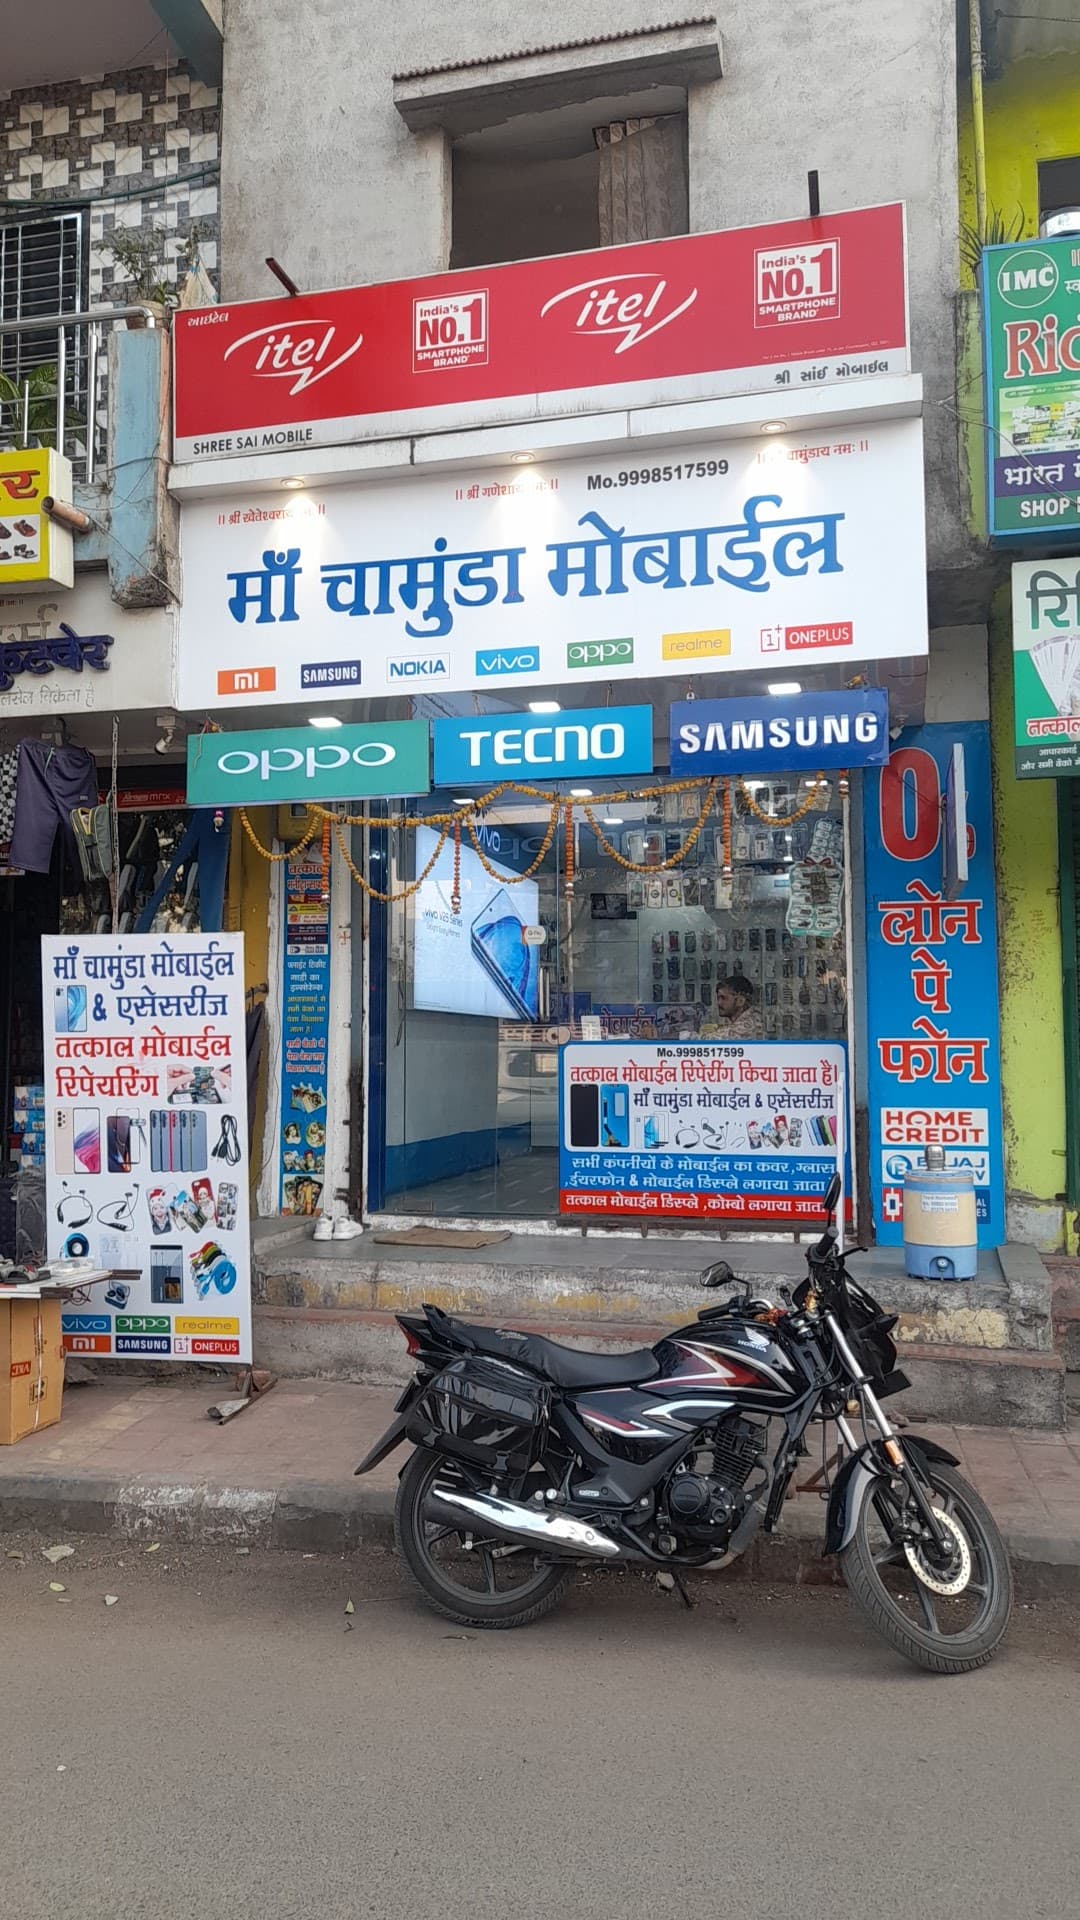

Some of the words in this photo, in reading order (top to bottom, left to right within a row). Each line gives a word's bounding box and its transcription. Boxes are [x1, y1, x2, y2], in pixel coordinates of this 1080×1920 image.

[761, 254, 806, 269] India's
[1002, 266, 1055, 292] IMC
[420, 304, 459, 318] India's
[576, 281, 667, 327] itel
[759, 297, 837, 315] SMARTPHONE
[777, 309, 816, 321] BRAND
[255, 326, 336, 370] itel
[416, 345, 485, 361] SMARTPHONE
[433, 356, 468, 367] BRAND
[193, 440, 233, 455] SHREE
[236, 436, 259, 450] SAI
[262, 428, 313, 446] MOBILE
[587, 459, 729, 490] Mo.9998517599
[1003, 463, 1066, 486] भारत
[1020, 498, 1071, 518] SHOP
[226, 547, 303, 625] माँ
[320, 537, 527, 638] चामुंडा
[546, 494, 845, 597] मोबाईल
[303, 666, 358, 684] SAMSUNG
[389, 659, 447, 677] NOKIA
[480, 653, 536, 672] vivo
[568, 640, 632, 663] oppo
[669, 636, 723, 653] realme
[788, 627, 850, 645] ONEPLUS
[459, 722, 625, 768] TECNO
[680, 711, 879, 755] SAMSUNG
[878, 878, 983, 945] लोन
[53, 945, 79, 980] माँ
[83, 944, 146, 990] चामुंडा
[151, 941, 234, 981] मोबाईल
[911, 947, 952, 1014] पे
[92, 993, 108, 1022] &
[116, 985, 228, 1025] एसेसरीज
[55, 1036, 135, 1058] तत्काल
[140, 1025, 232, 1060] मोबाईल
[657, 1047, 744, 1058] Mo.9998517599
[877, 1016, 990, 1084] फोन
[55, 1065, 159, 1097] रिपेयरिंग
[570, 1067, 618, 1083] तत्काल
[622, 1059, 677, 1085] मोबाईल
[739, 1059, 778, 1083] किया
[782, 1067, 817, 1083] जाता
[633, 1087, 651, 1107] माँ
[653, 1087, 692, 1113] चामुंडा
[697, 1087, 750, 1110] मोबाईल
[755, 1093, 763, 1107] &
[767, 1087, 834, 1113] एसेसरीज
[886, 1111, 973, 1126] HOME
[885, 1127, 984, 1143] CREDIT
[572, 1154, 600, 1169] सभी
[660, 1156, 674, 1170] के
[678, 1156, 729, 1172] मोबाईल
[734, 1161, 752, 1172] का
[629, 1173, 639, 1187] &
[643, 1173, 694, 1190] मोबाईल
[697, 1174, 738, 1189] डिस्प्ले
[743, 1178, 789, 1191] लगाया
[793, 1180, 825, 1192] जाता
[566, 1194, 607, 1206] तत्काल
[610, 1192, 658, 1209] मोबाईल
[660, 1193, 699, 1209] डिस्प्ले
[748, 1200, 792, 1212] लगाया
[62, 1317, 107, 1330] vivo
[117, 1318, 169, 1331] oppo
[182, 1320, 232, 1331] realme
[118, 1340, 168, 1350] SAMSUNG
[194, 1342, 237, 1352] ONEPLUS
